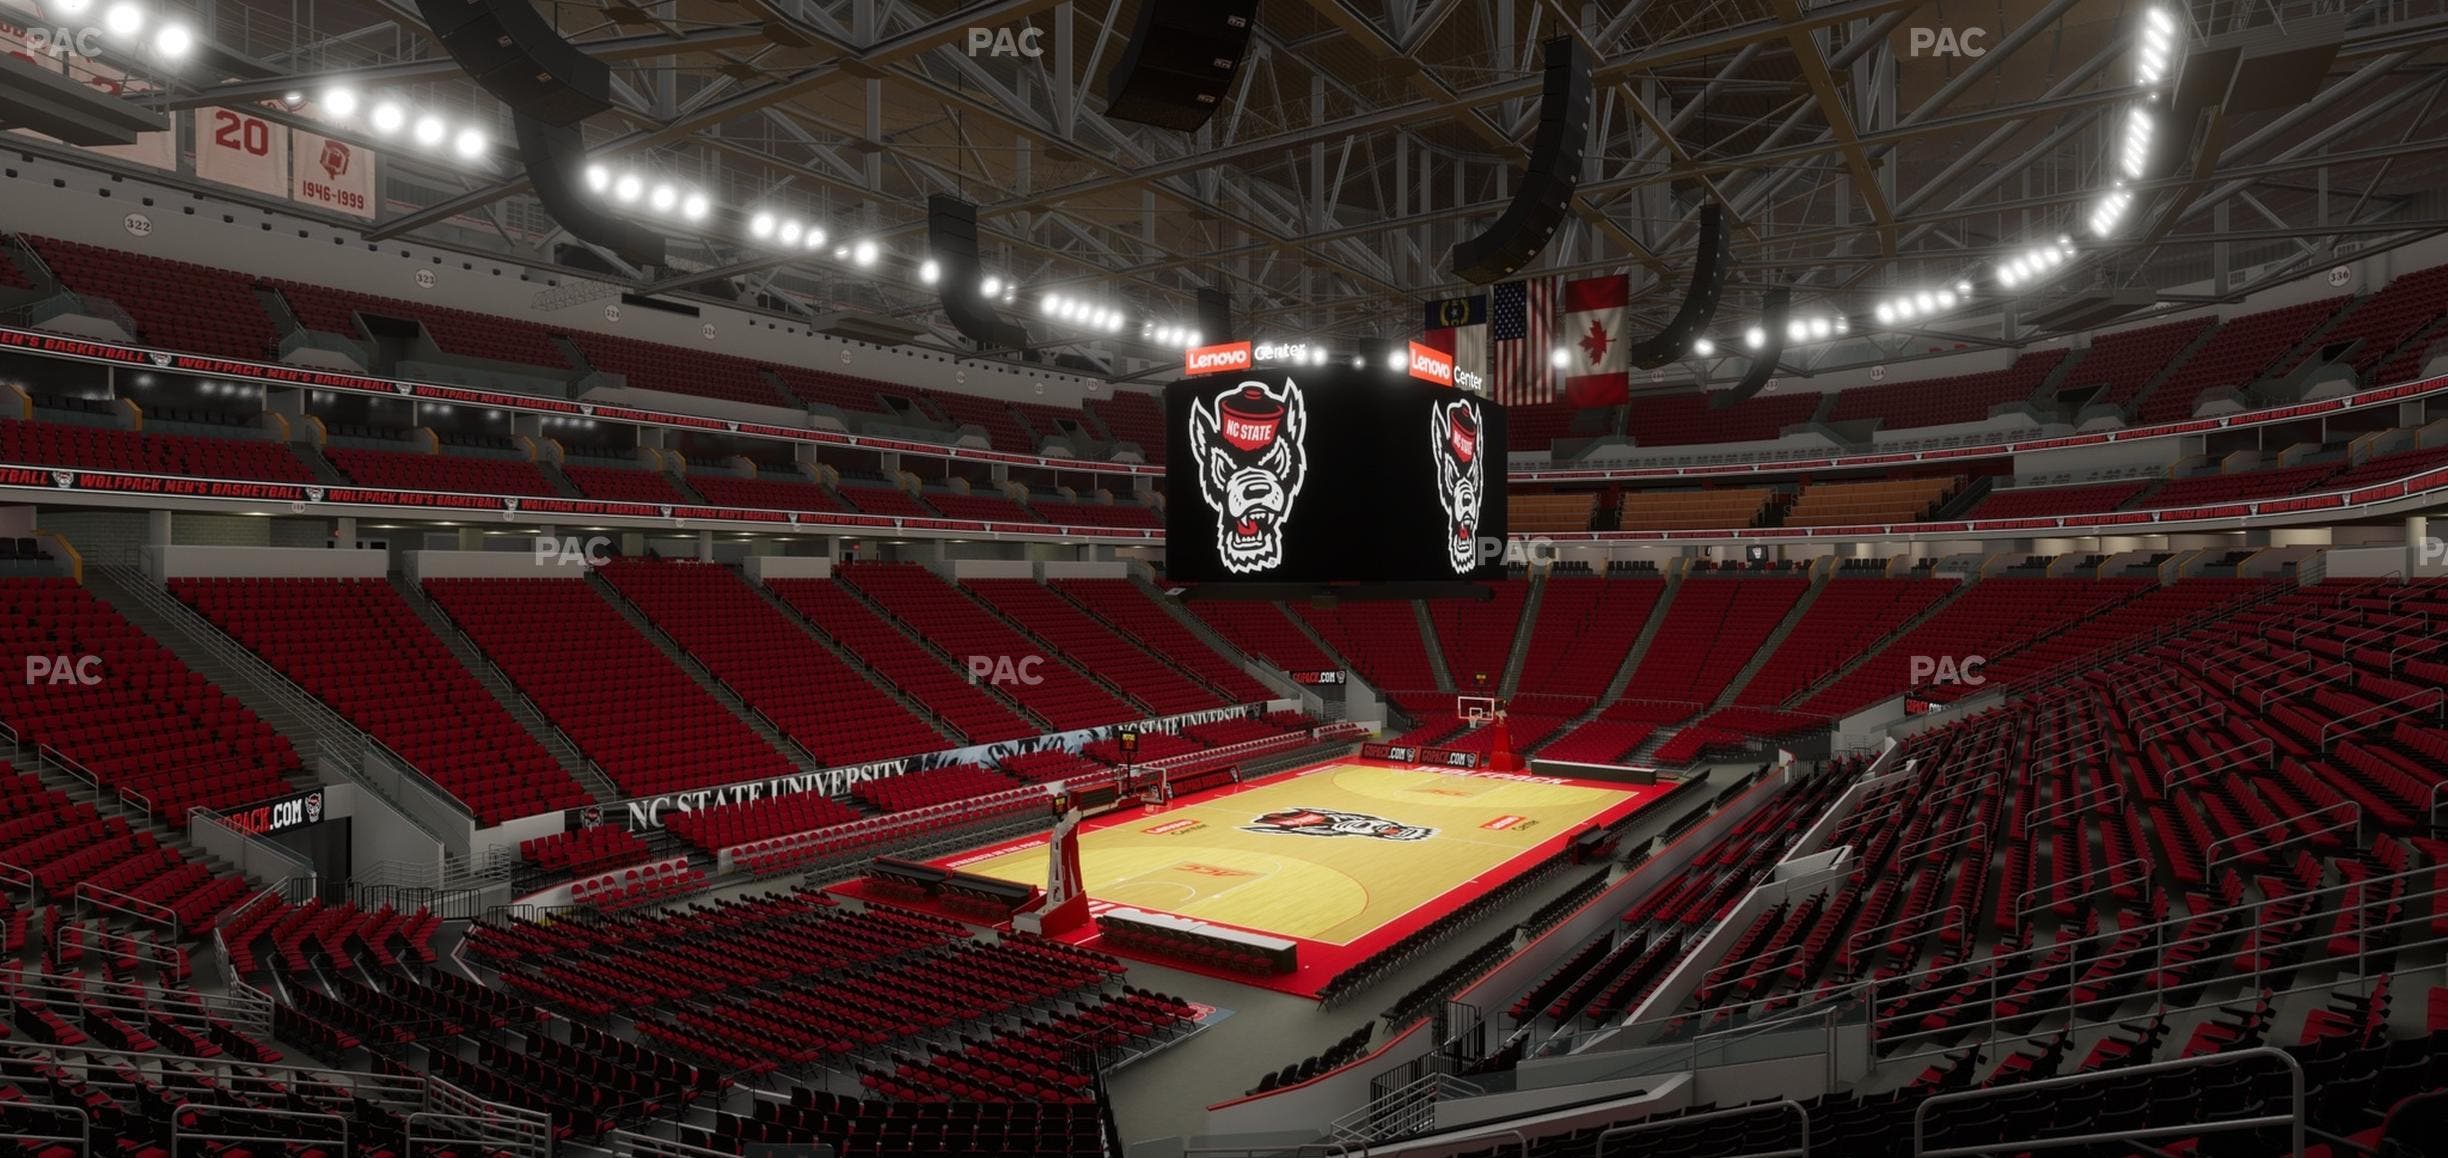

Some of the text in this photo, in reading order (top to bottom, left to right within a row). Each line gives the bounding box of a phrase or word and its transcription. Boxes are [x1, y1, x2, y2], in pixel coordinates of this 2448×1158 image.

[216, 110, 269, 157] 20
[303, 180, 365, 210] 1946-1999
[127, 218, 151, 232] 322
[0, 331, 145, 363] EN'S BASKETBALL
[1189, 343, 1306, 369] Lenovo Center
[177, 357, 263, 377] WOLFPACK
[315, 373, 394, 392] BASKETBALL
[1411, 348, 1482, 390] Lenovo Center
[416, 385, 478, 400] WOLFPACK
[515, 398, 578, 413] BASKETBALL
[1226, 419, 1272, 442] NC STATE
[80, 473, 304, 501] WOLFPACK MEN'S BASKETBALL
[328, 489, 505, 510] WOLFPACK MEN'S BASKETBALL
[1140, 715, 1181, 736] STATE
[628, 759, 911, 832] NC STATE UNIVERSITY
